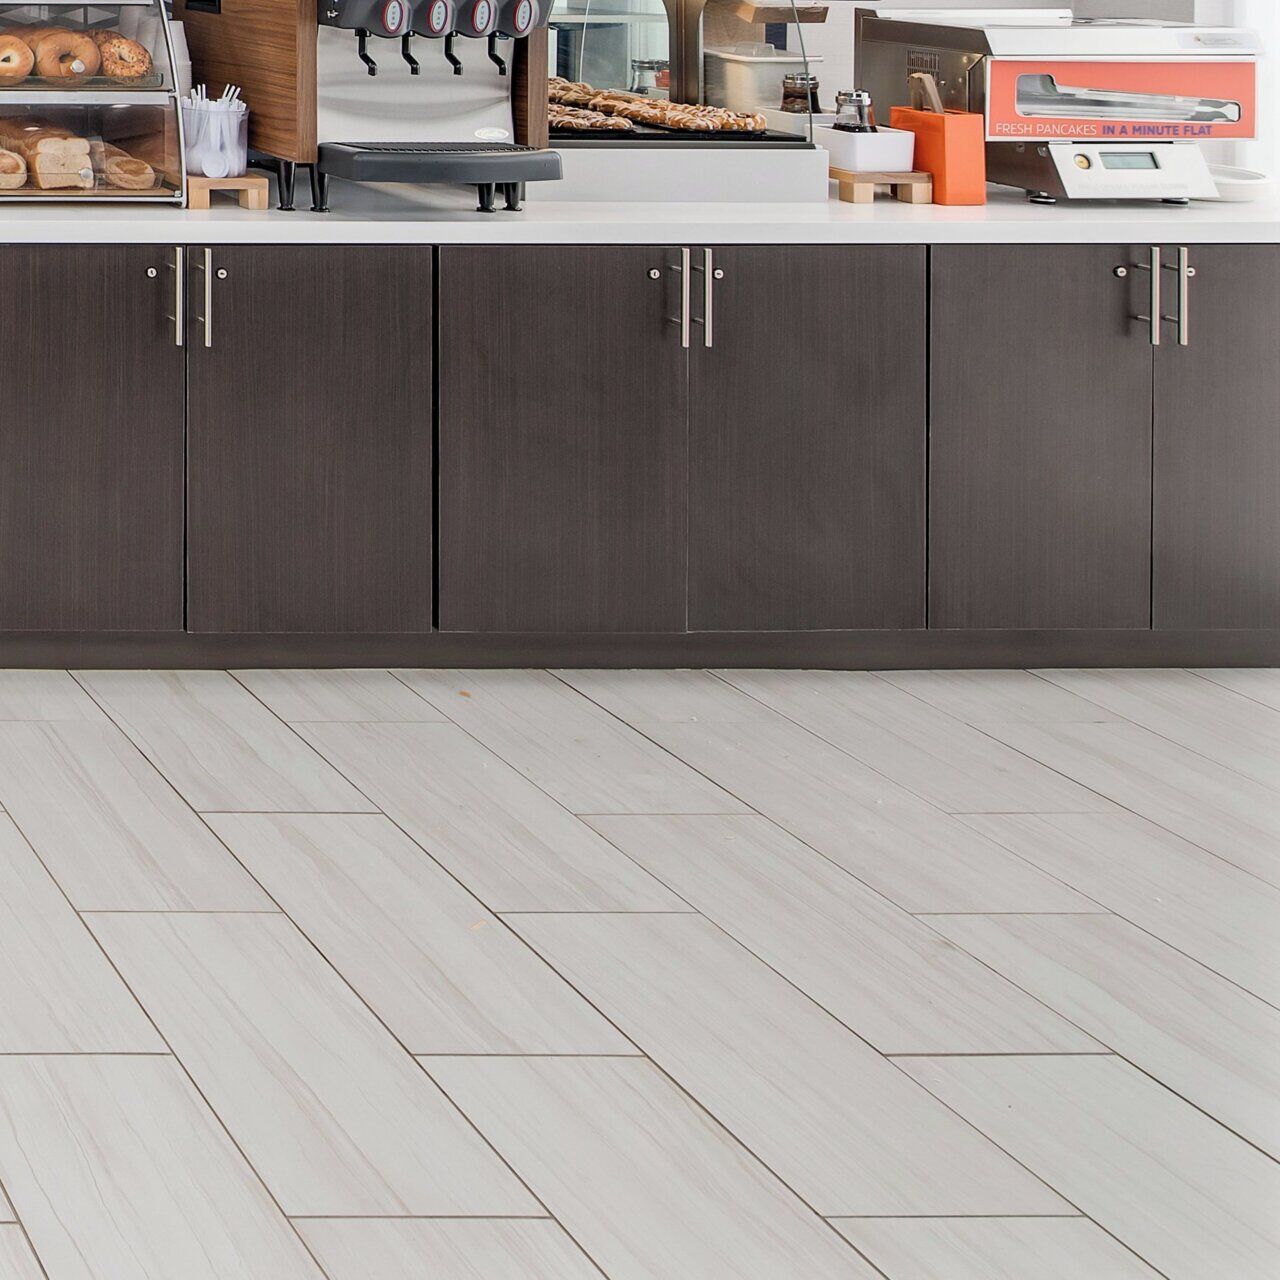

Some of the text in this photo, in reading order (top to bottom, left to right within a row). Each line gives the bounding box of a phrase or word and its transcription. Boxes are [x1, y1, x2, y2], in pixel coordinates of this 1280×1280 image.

[995, 122, 1213, 136] FRESH PANCAKES IN A MINUTE FLAT
